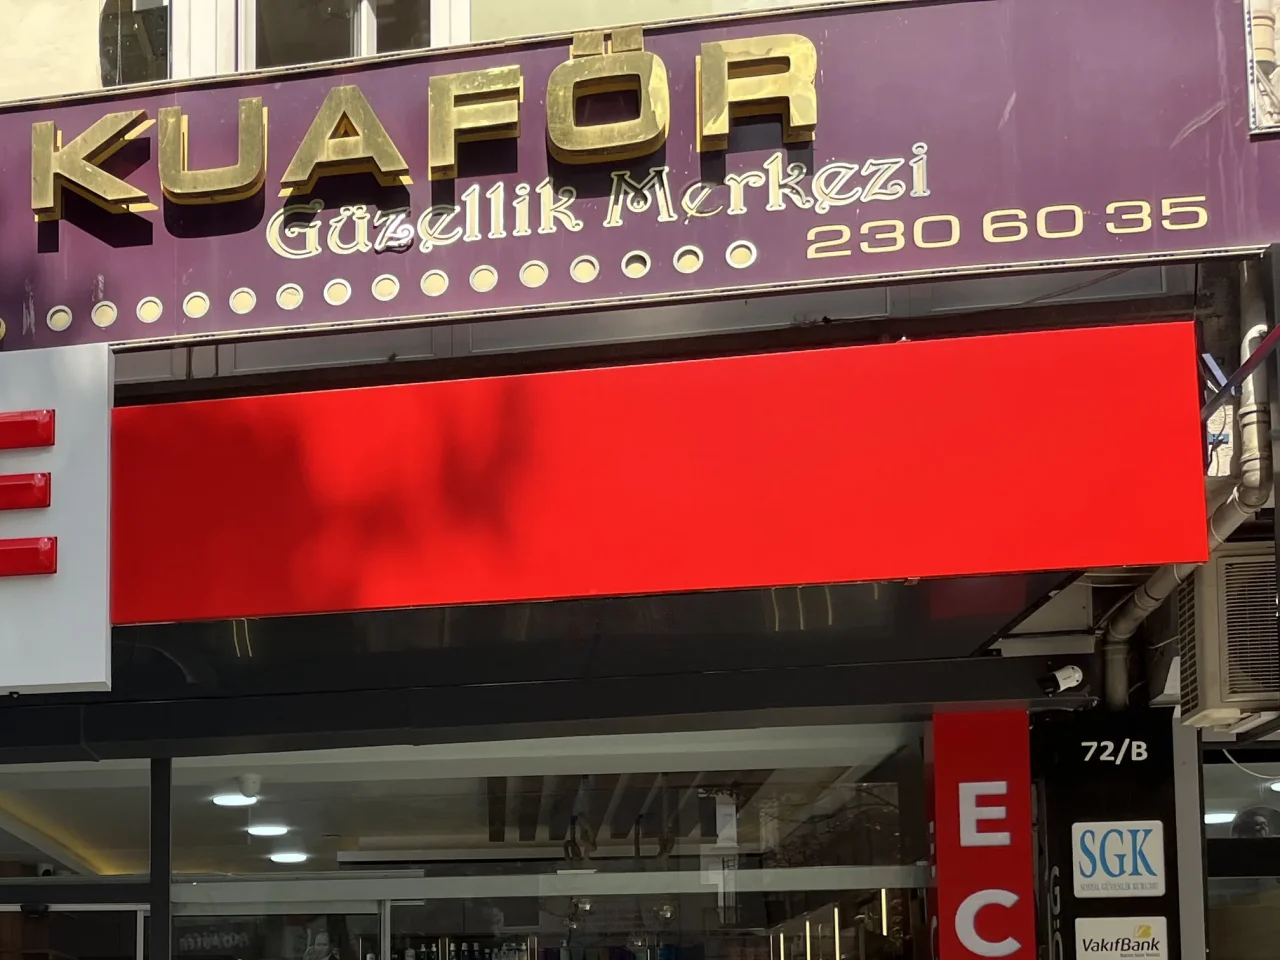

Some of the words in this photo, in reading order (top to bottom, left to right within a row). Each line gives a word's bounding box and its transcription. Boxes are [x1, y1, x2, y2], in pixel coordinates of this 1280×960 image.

[31, 26, 819, 222] KUAFÖR
[265, 176, 584, 259] Güzellik
[602, 142, 932, 227] Merkezi
[806, 214, 961, 259] 230
[982, 204, 1085, 243] 60
[1105, 195, 1209, 234] 35
[1081, 738, 1148, 765] 72/B
[1078, 828, 1158, 879] SGK
[1082, 937, 1160, 952] VakıfBank
